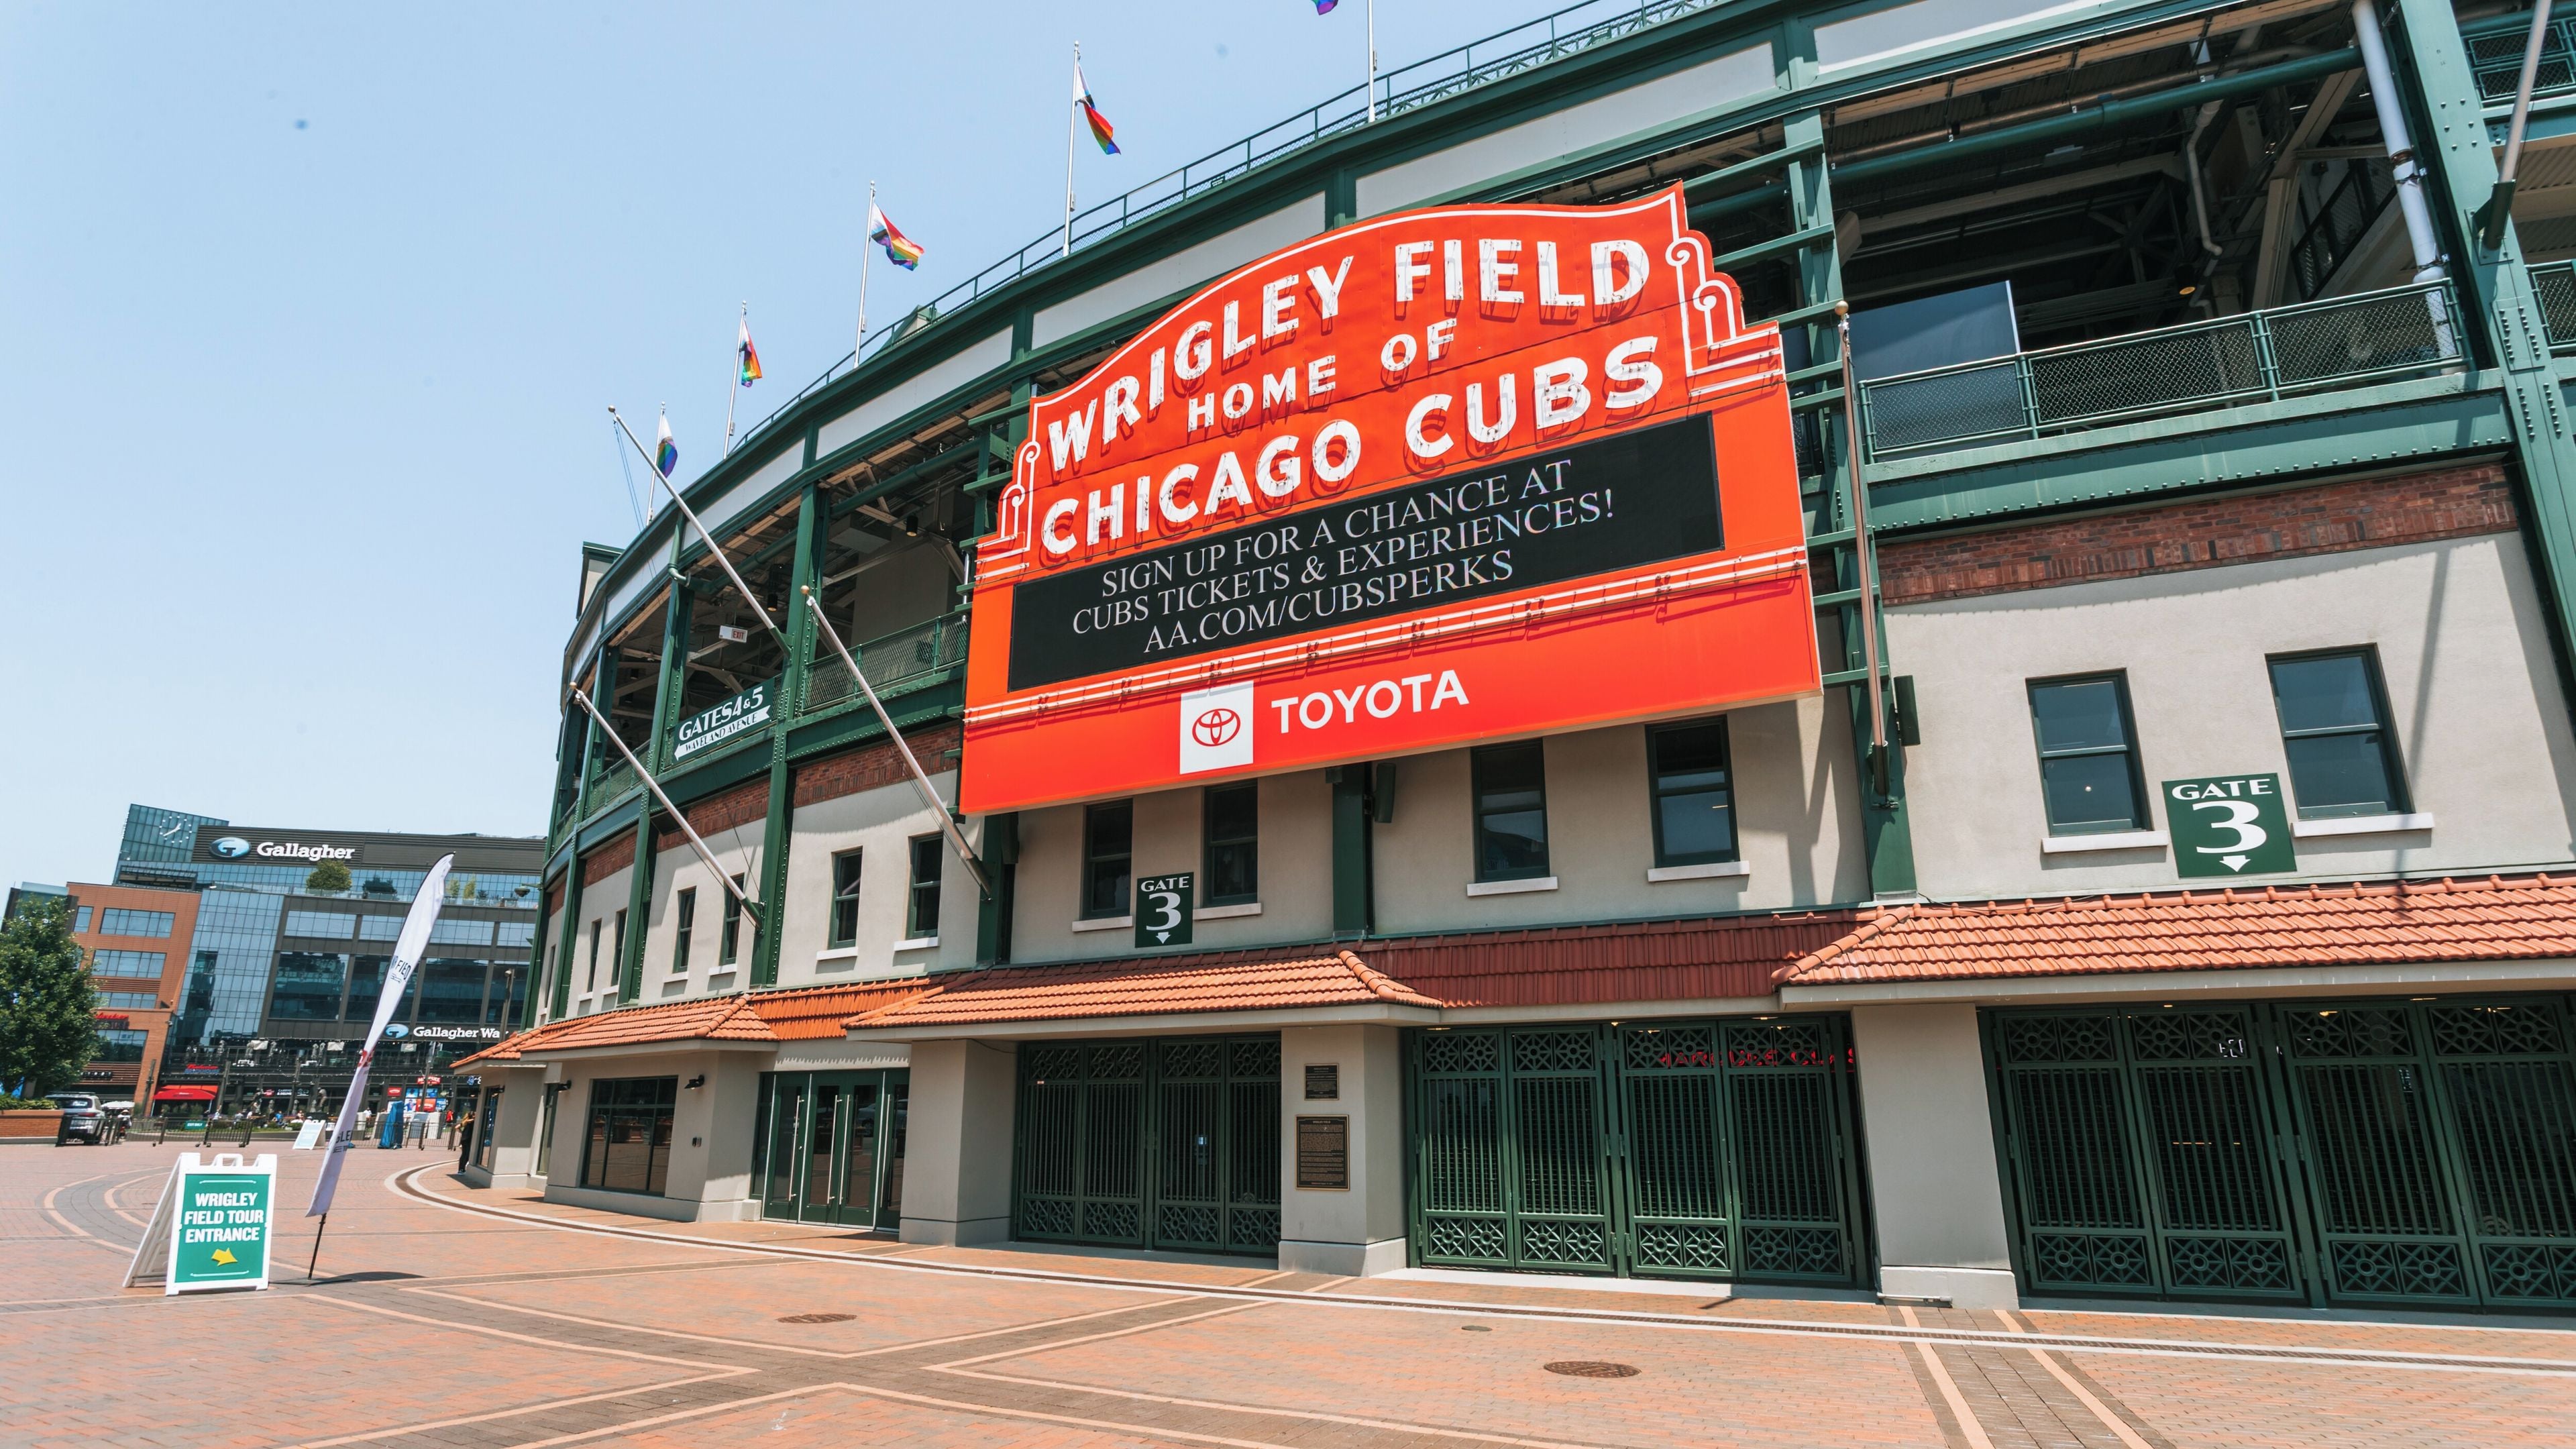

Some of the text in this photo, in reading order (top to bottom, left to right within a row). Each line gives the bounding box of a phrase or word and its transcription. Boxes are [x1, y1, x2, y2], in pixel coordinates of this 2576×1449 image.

[1048, 238, 1650, 472] WRIGLEY FIELD
[1187, 317, 1457, 433] HOME OF
[1041, 336, 1664, 555] CHICAGO CUBS
[1102, 458, 1572, 598] SIGN UP FOR A CHANCE AT
[1072, 488, 1614, 635] CUBS TICKETS & EXPERIENCES!
[1142, 549, 1514, 654] AA.COM/CUBSPERKS
[1271, 669, 1470, 734] TOYOTA
[678, 702, 733, 741] GATES
[685, 712, 757, 752] WAVELAND AVENUE
[2171, 778, 2273, 800] GATE
[2192, 800, 2267, 853] 3
[256, 841, 356, 861] Gallagher
[1140, 876, 1189, 892] GATE
[1146, 892, 1181, 931] 3
[413, 1026, 479, 1039] Gallagher
[480, 1028, 508, 1038] Wa
[184, 1210, 264, 1226] FIELD TOUR
[195, 1192, 258, 1208] WRIGLEY
[184, 1226, 260, 1244] ENTRANCE
